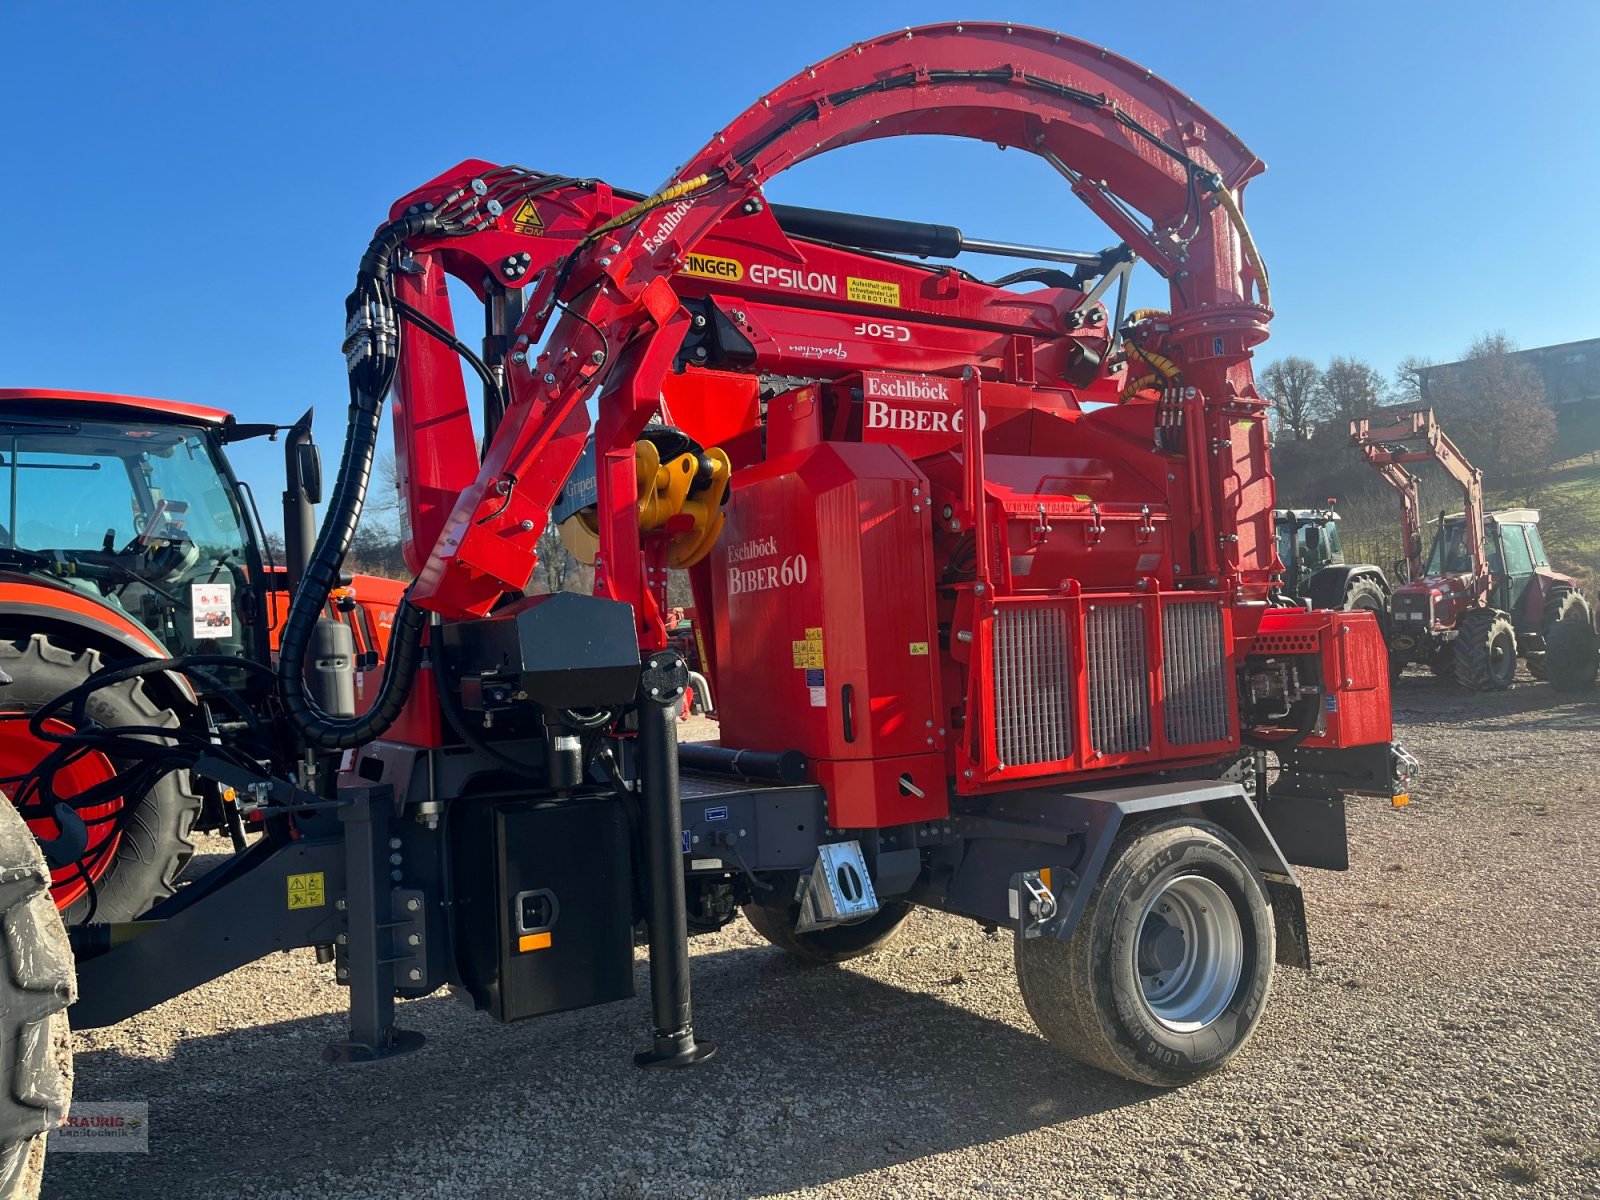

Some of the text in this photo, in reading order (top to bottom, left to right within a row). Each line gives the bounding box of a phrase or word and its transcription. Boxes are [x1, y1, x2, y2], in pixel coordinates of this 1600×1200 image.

[749, 264, 836, 294] EPSILON
[854, 322, 910, 342] C50F
[867, 377, 949, 400] Eschlböck
[866, 400, 987, 433] BIBER 6
[727, 535, 777, 563] Eschlböck
[728, 554, 807, 595] BIBER 60
[1147, 1042, 1181, 1066] LONG
